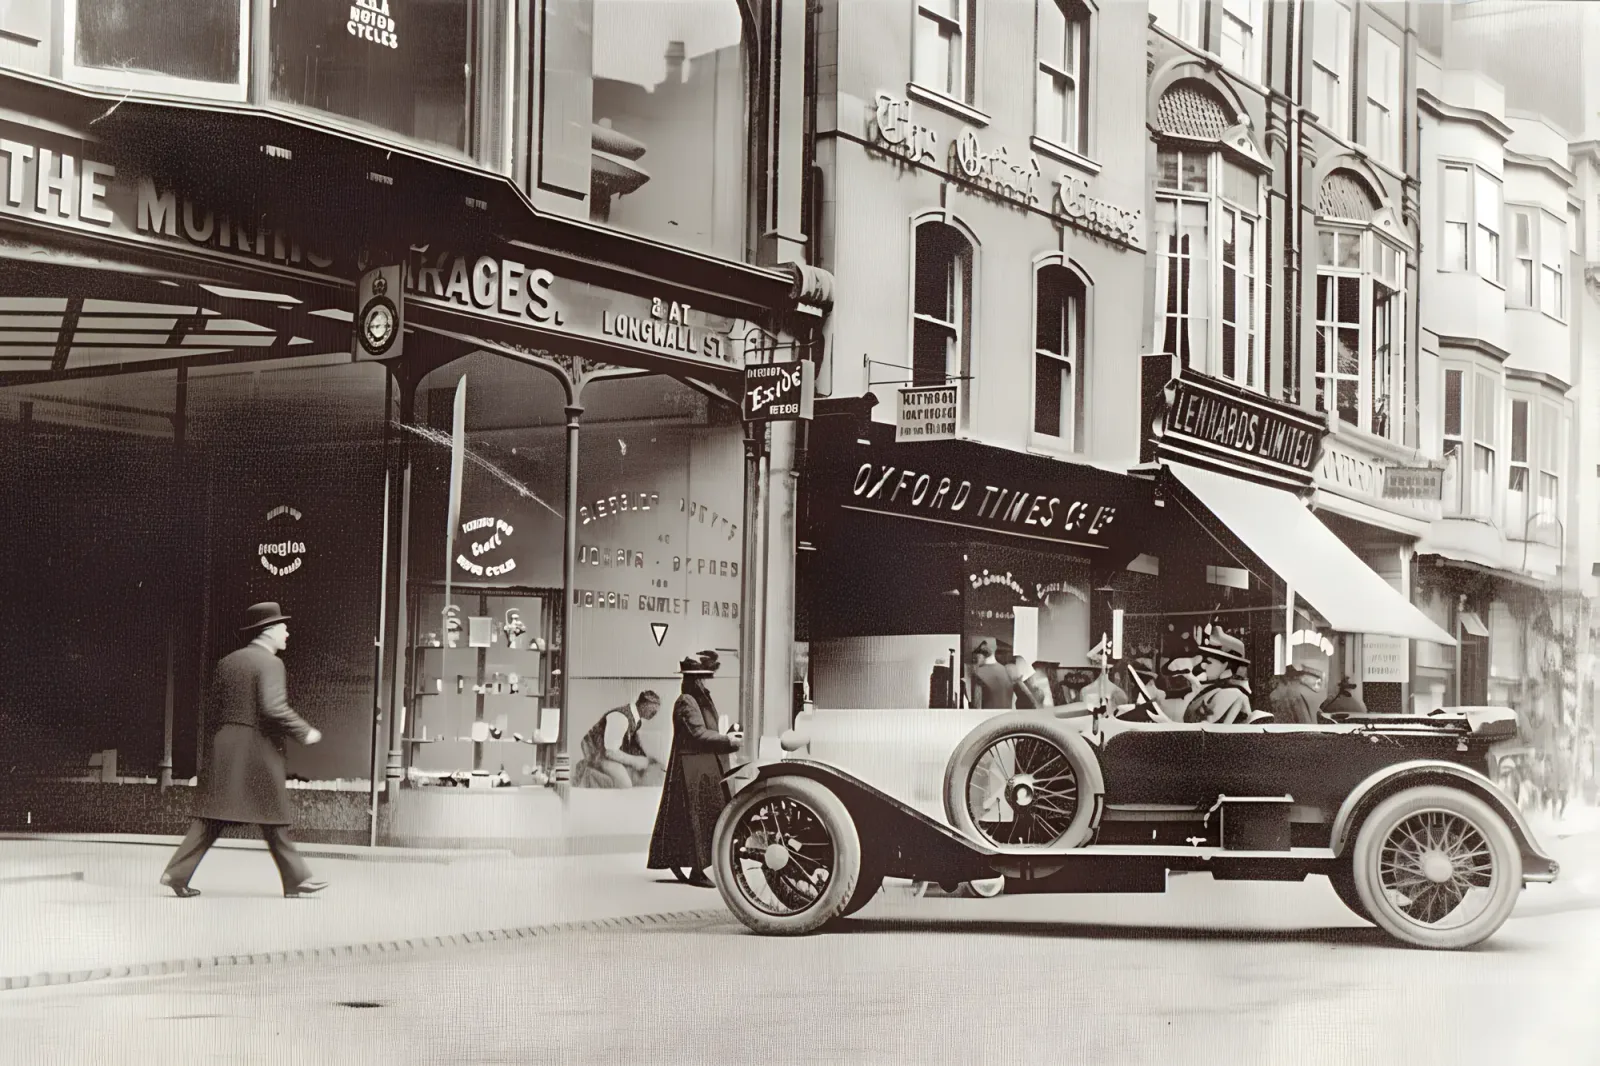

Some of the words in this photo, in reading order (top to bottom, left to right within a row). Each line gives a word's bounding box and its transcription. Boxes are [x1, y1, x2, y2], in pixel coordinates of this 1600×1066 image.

[0, 138, 115, 226] THE
[602, 310, 698, 354] LONGWALL
[668, 301, 692, 327] AT
[1258, 418, 1315, 468] LIMITED
[853, 462, 972, 512] OXFORD
[976, 485, 1061, 528] TIMES
